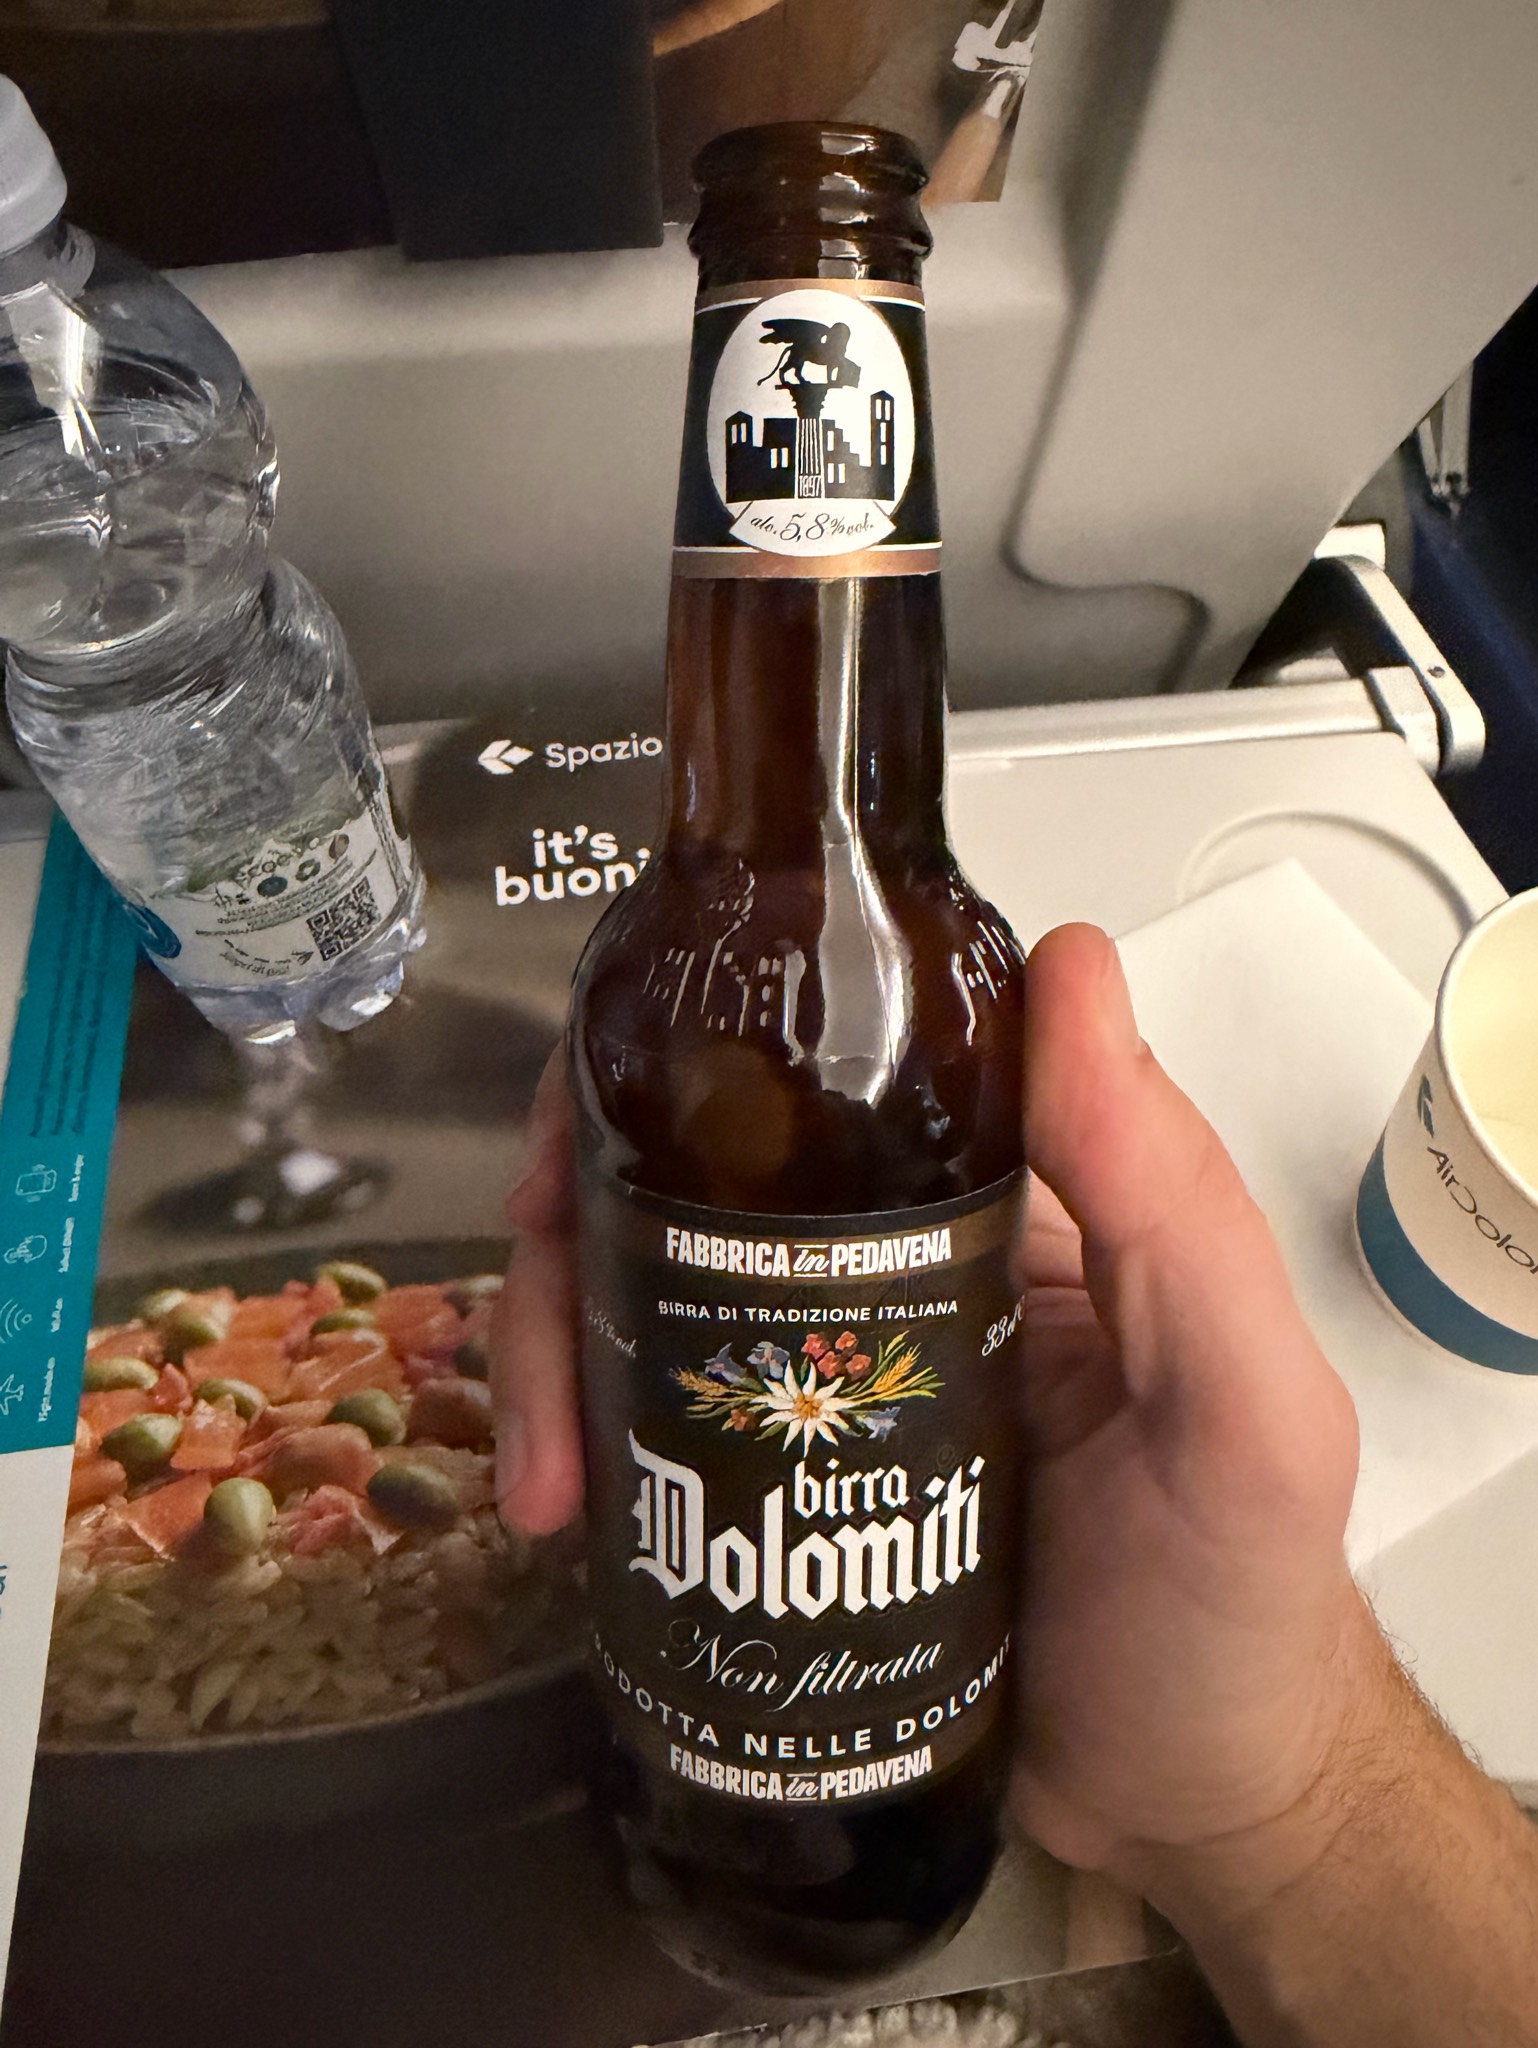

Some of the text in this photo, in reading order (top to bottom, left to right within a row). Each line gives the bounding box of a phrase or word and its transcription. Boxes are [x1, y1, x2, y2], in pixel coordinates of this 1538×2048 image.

[799, 474, 821, 498] 1897
[545, 731, 663, 773] Spazio
[532, 824, 619, 868] it's
[1426, 1146, 1538, 1274] AirDolo
[666, 1226, 952, 1278] FABBRICA in PEDAVENA
[658, 1300, 958, 1323] BIRRA DI TRADIZIONE ITALIANA
[794, 1458, 910, 1519] birra
[628, 1428, 986, 1620] Dolomiti
[659, 1618, 945, 1713] Non filtrata
[595, 1632, 720, 1748] ODOTTA
[744, 1728, 872, 1759] NELLE
[670, 1743, 932, 1801] FABBRICA in PEDAVENA
